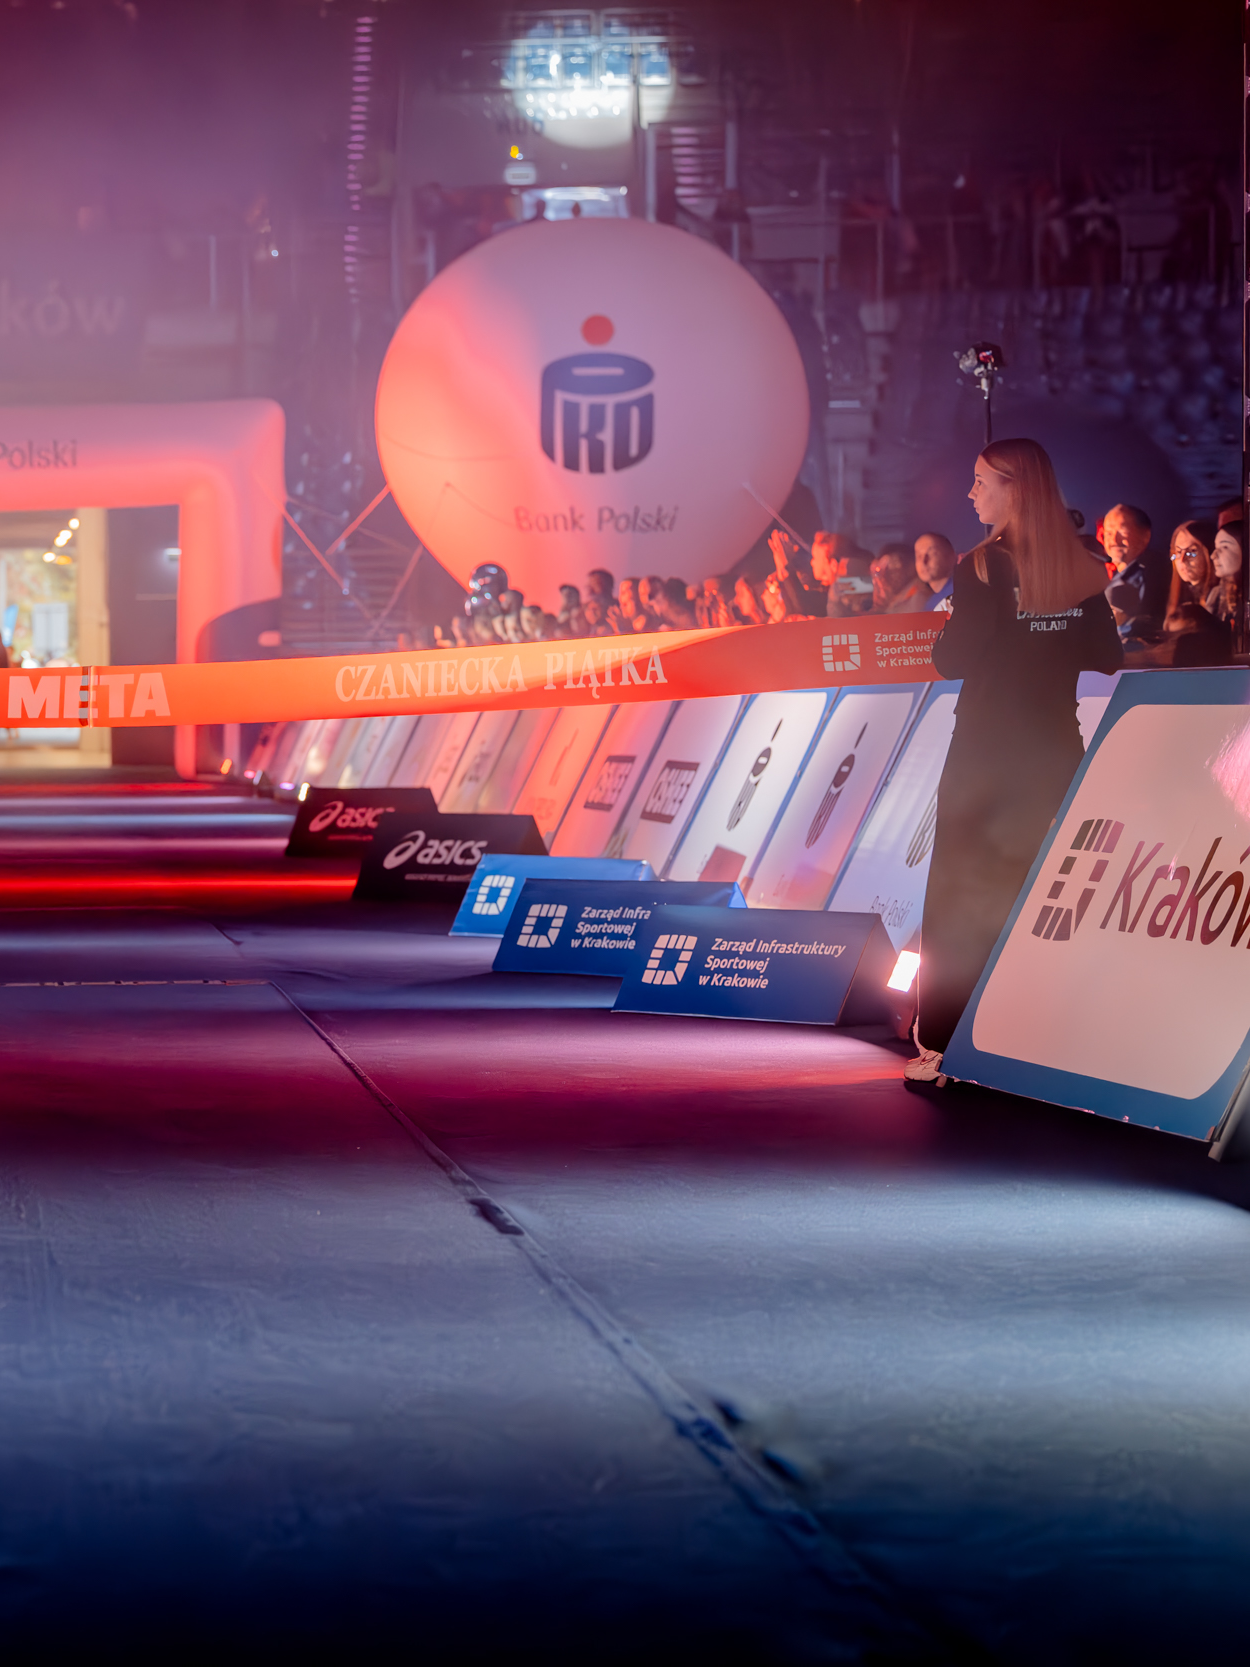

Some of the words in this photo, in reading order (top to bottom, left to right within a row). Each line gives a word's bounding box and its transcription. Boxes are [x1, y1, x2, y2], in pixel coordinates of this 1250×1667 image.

[513, 505, 585, 533] Bank
[598, 505, 680, 533] Polski
[1030, 620, 1067, 631] POLAND
[874, 630, 913, 643] Zarząd
[877, 660, 887, 668] w
[335, 655, 528, 702] CZANIECKA
[544, 645, 668, 700] PIĄTKA
[7, 672, 171, 719] META
[416, 839, 488, 866] asics
[580, 906, 622, 922] Zarząd
[575, 921, 636, 937] Sportowej
[570, 938, 581, 949] w
[582, 937, 636, 949] Krakowie
[711, 938, 757, 955] Zarząd
[757, 939, 847, 958] Infrastruktury
[704, 955, 770, 973] Sportowej
[698, 975, 710, 986] w
[710, 973, 769, 989] Krakowie
